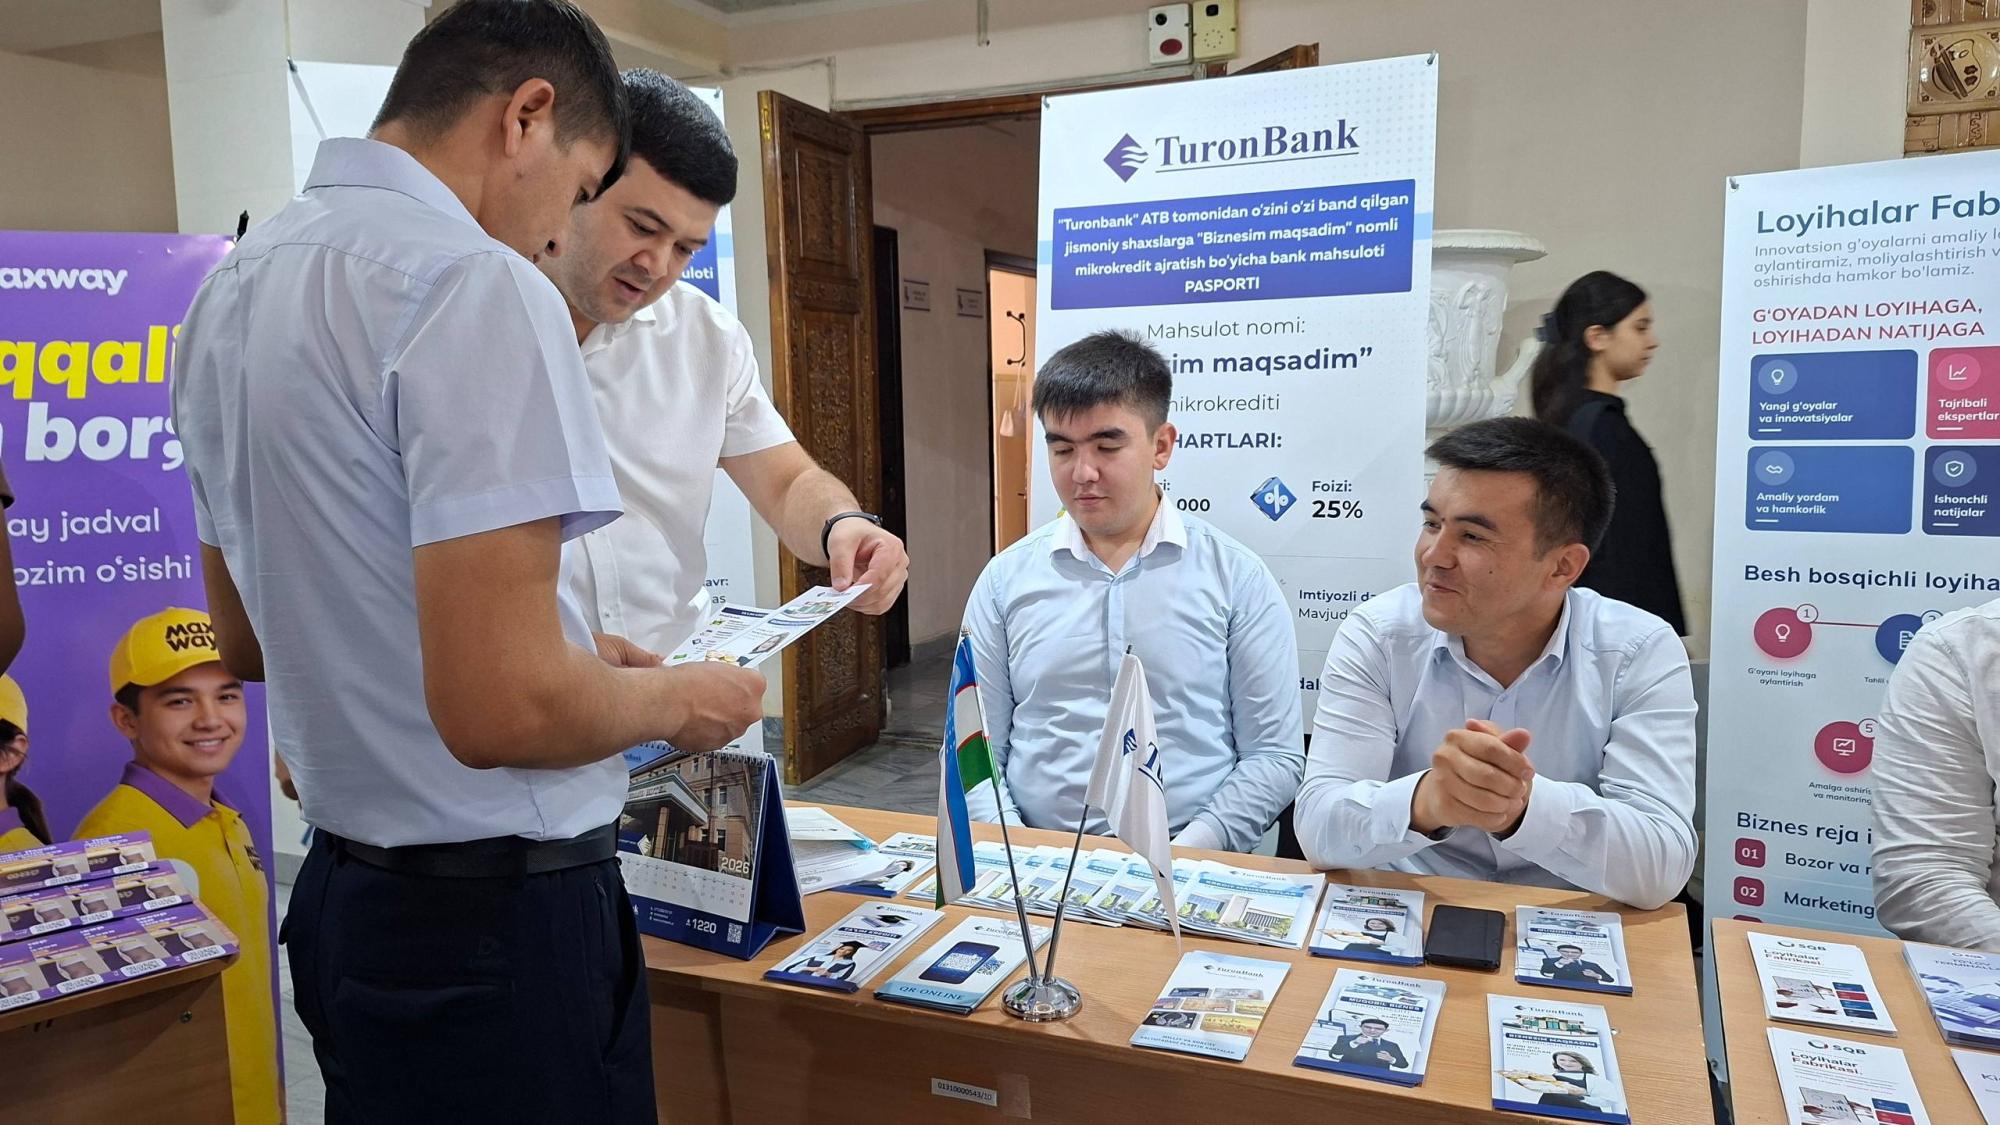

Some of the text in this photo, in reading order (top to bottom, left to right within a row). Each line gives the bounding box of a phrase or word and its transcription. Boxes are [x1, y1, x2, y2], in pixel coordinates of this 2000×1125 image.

[1156, 119, 1359, 167] TuronBank
[1059, 213, 1138, 231] "Turonbank"
[1141, 212, 1169, 225] ATB
[1172, 206, 1248, 224] tomonidan
[1319, 196, 1356, 211] band
[1360, 193, 1408, 212] qilgan
[1758, 200, 1920, 237] Loyihalar
[1064, 218, 1398, 257] jismoniy shaxslarga "Biznesim maqsadim" nomli
[1755, 241, 1842, 257] Innovatsion
[1931, 229, 1988, 244] amaliy
[1075, 259, 1151, 276] mikrokredit
[1154, 257, 1206, 274] ajratish
[1270, 249, 1306, 265] bank
[1310, 244, 1385, 262] mahsuloti
[1754, 256, 1852, 274] aylantiramiz,
[1857, 246, 1985, 267] moliyalashtirish
[1185, 277, 1260, 293] PASPORTI
[1754, 273, 1831, 288] oshirishda
[1836, 269, 1896, 282] hamkor
[1865, 299, 1983, 317] LOYIHAGA,
[1147, 317, 1305, 339] Mahsulot nomi:
[1752, 322, 1985, 344] LOYIHADAN NATIJAGA
[1168, 358, 1203, 374] im
[1760, 401, 1789, 412] Yangi
[1938, 398, 1987, 410] Tajribali
[1759, 413, 1853, 424] va innovatsiyalar
[1938, 412, 2000, 422] ekspertlar
[1312, 480, 1353, 493] Foizi:
[1757, 492, 1839, 503] Amaliy yordam
[1934, 495, 1988, 504] Ishonchli
[1177, 498, 1210, 512] 000
[1311, 499, 1364, 519] 25%
[1772, 504, 1826, 514] hamkorlik
[1934, 508, 1985, 518] natijalar
[60, 507, 160, 542] jadval
[1745, 565, 2000, 593] Besh bosqichli loyiha
[1299, 590, 1356, 602] Imtiyozli
[1298, 608, 1348, 621] Mavjud
[1804, 609, 1809, 618] 1
[1781, 669, 1816, 679] loyihaga
[1760, 678, 1803, 687] aylantirish
[1866, 724, 1873, 733] 5
[1809, 781, 1843, 792] Amalga
[1826, 793, 1872, 805] monitoring
[1737, 812, 1808, 836] Biznes
[1816, 825, 1859, 844] reja
[1742, 847, 1759, 860] 01
[721, 857, 749, 873] 2026
[1786, 852, 1832, 870] Bozor
[1839, 861, 1859, 874] va
[1740, 885, 1757, 898] 02
[1784, 891, 1875, 919] Marketing
[692, 918, 717, 934] 1220
[1799, 943, 1827, 951] SQB
[1764, 949, 1820, 960] Loyihalar
[1832, 1044, 1867, 1055] SQB
[1791, 1051, 1858, 1068] Loyihalar
